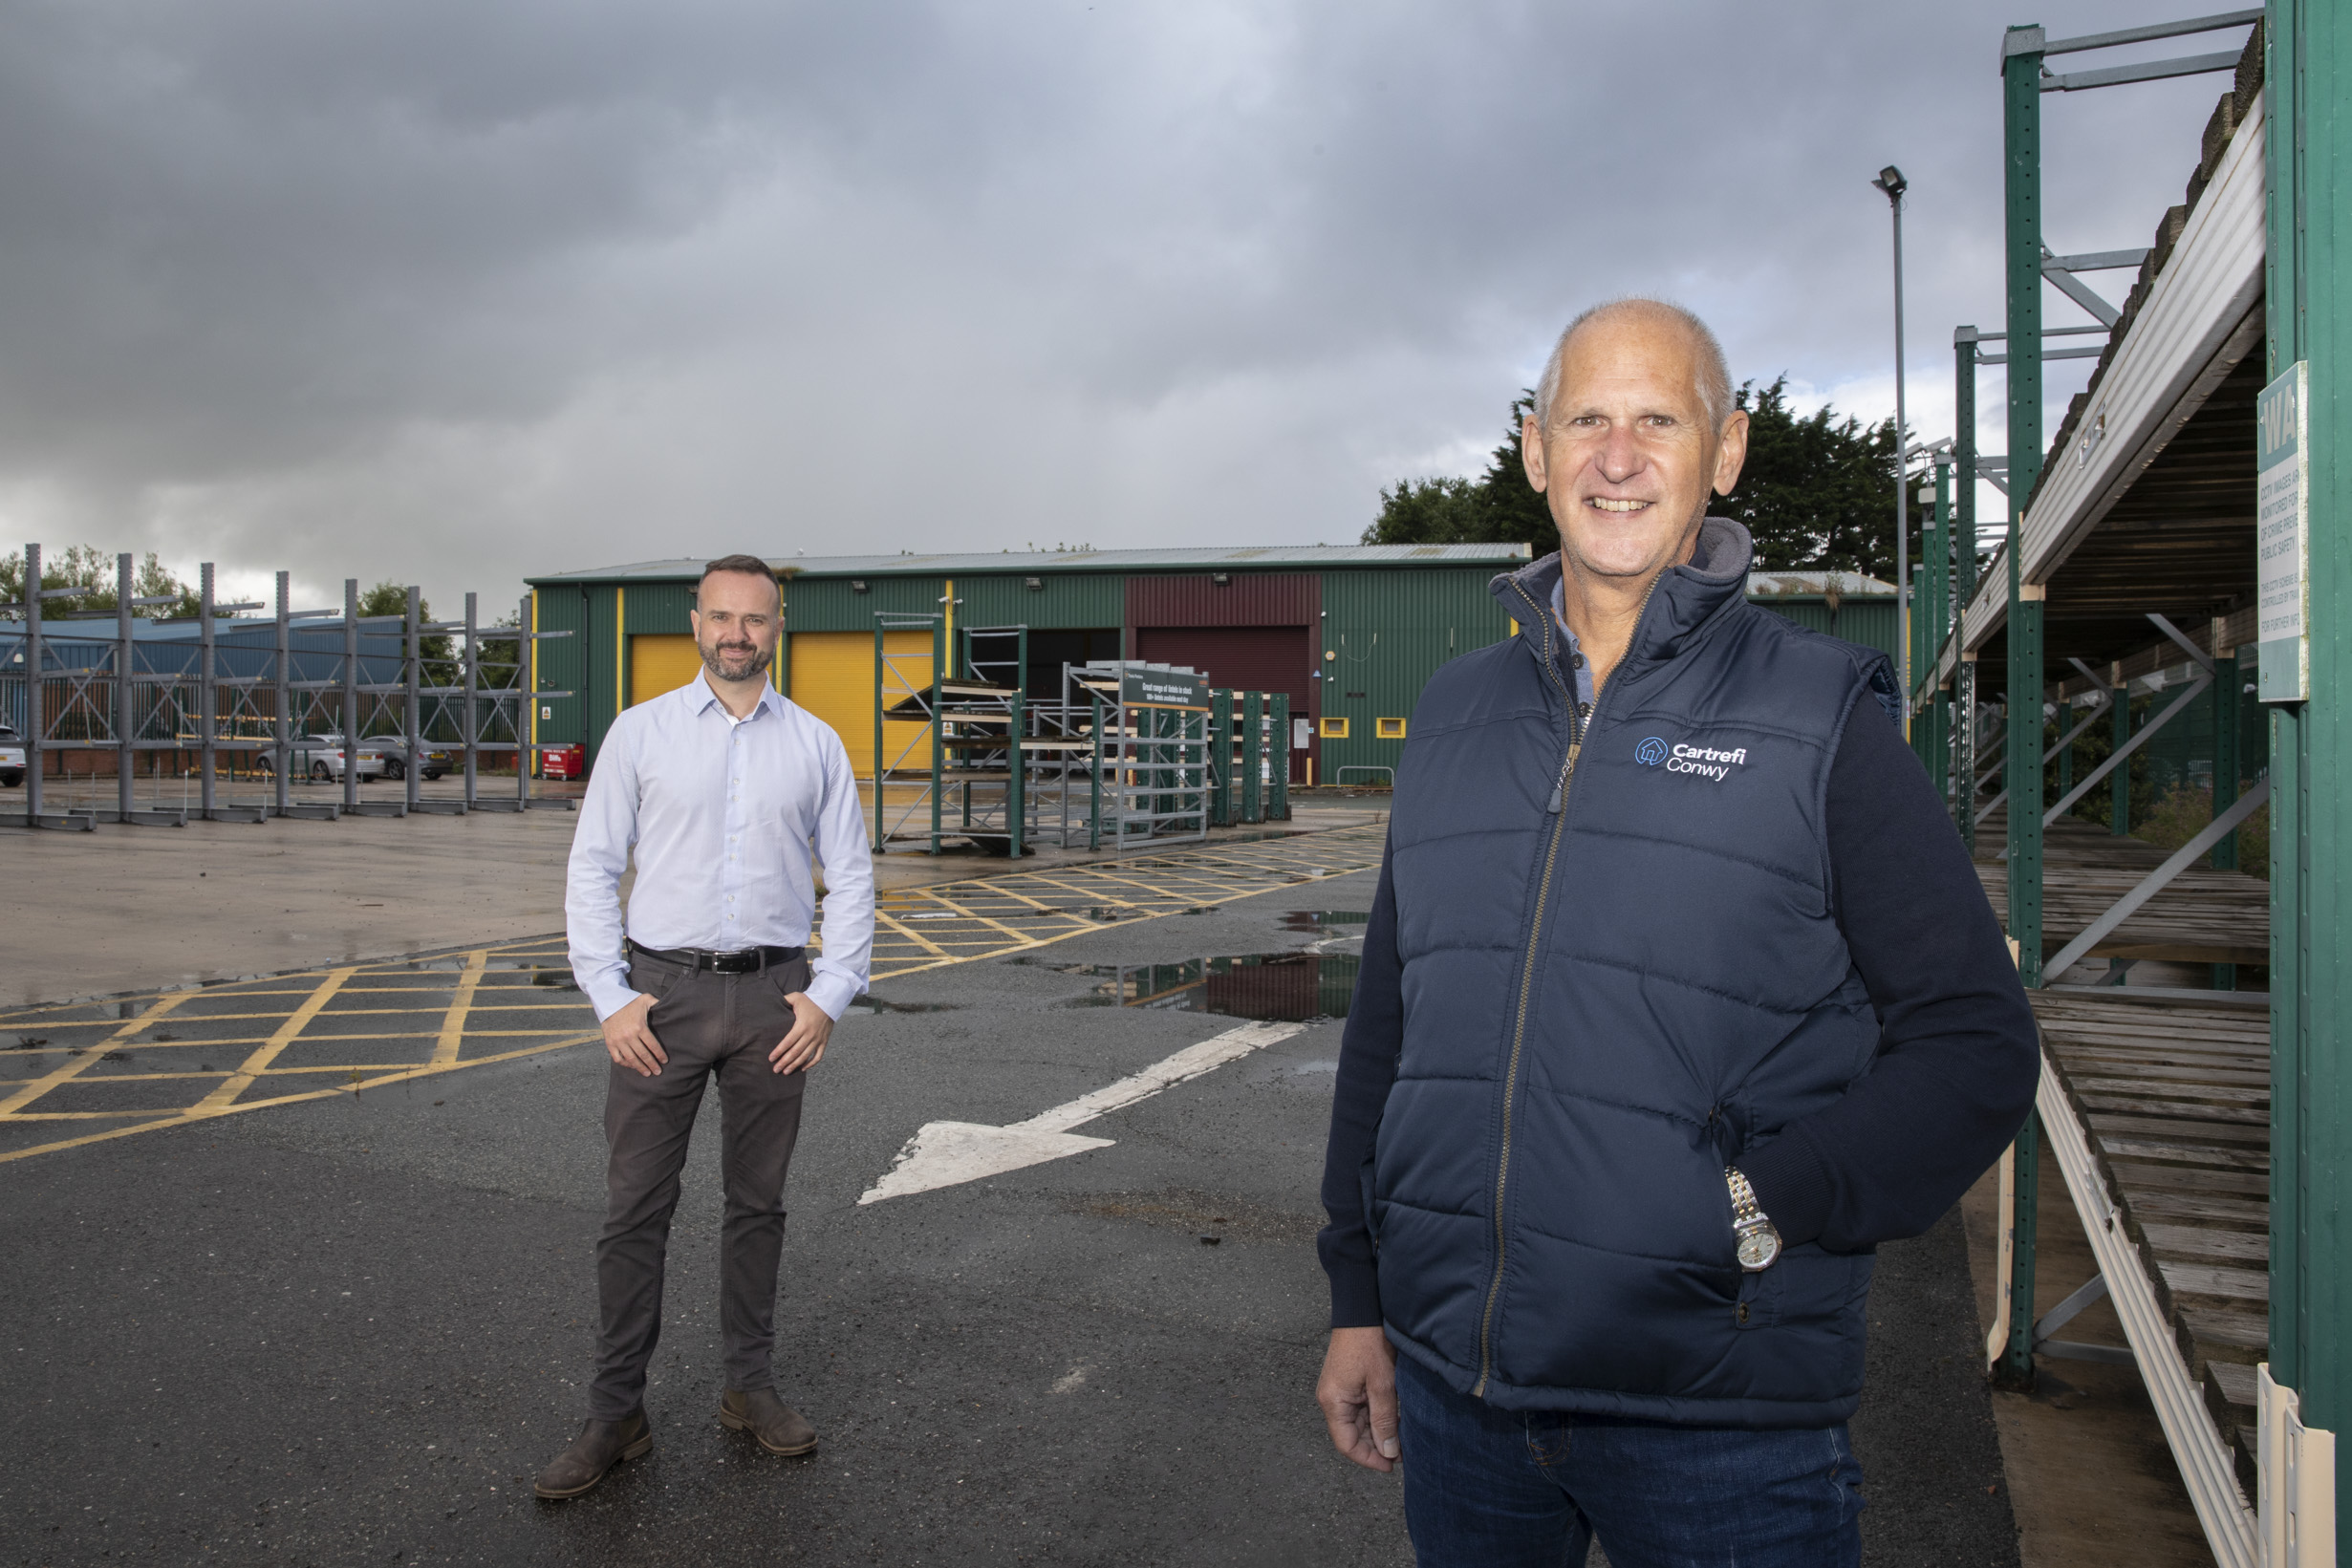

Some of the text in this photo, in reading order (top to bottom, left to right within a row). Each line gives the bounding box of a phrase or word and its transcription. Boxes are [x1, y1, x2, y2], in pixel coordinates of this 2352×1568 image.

[2261, 483, 2273, 501] CCTV
[2274, 473, 2291, 494] IMAGES
[2261, 491, 2298, 521] MONITORED FOR
[2261, 526, 2267, 541] OF
[2268, 520, 2283, 538] CRIME
[2261, 536, 2295, 561] PUBLIC SAFETY
[2270, 580, 2278, 591] CCTV
[2279, 574, 2293, 588] SCHEME
[2261, 592, 2283, 609] CONTROLLED
[2262, 620, 2270, 633] FOR
[2270, 615, 2289, 631] FURTHER
[1142, 682, 1152, 691] Great
[1153, 685, 1163, 694] range
[1672, 743, 1747, 765] Cartrefi
[1666, 757, 1729, 782] Conwy
